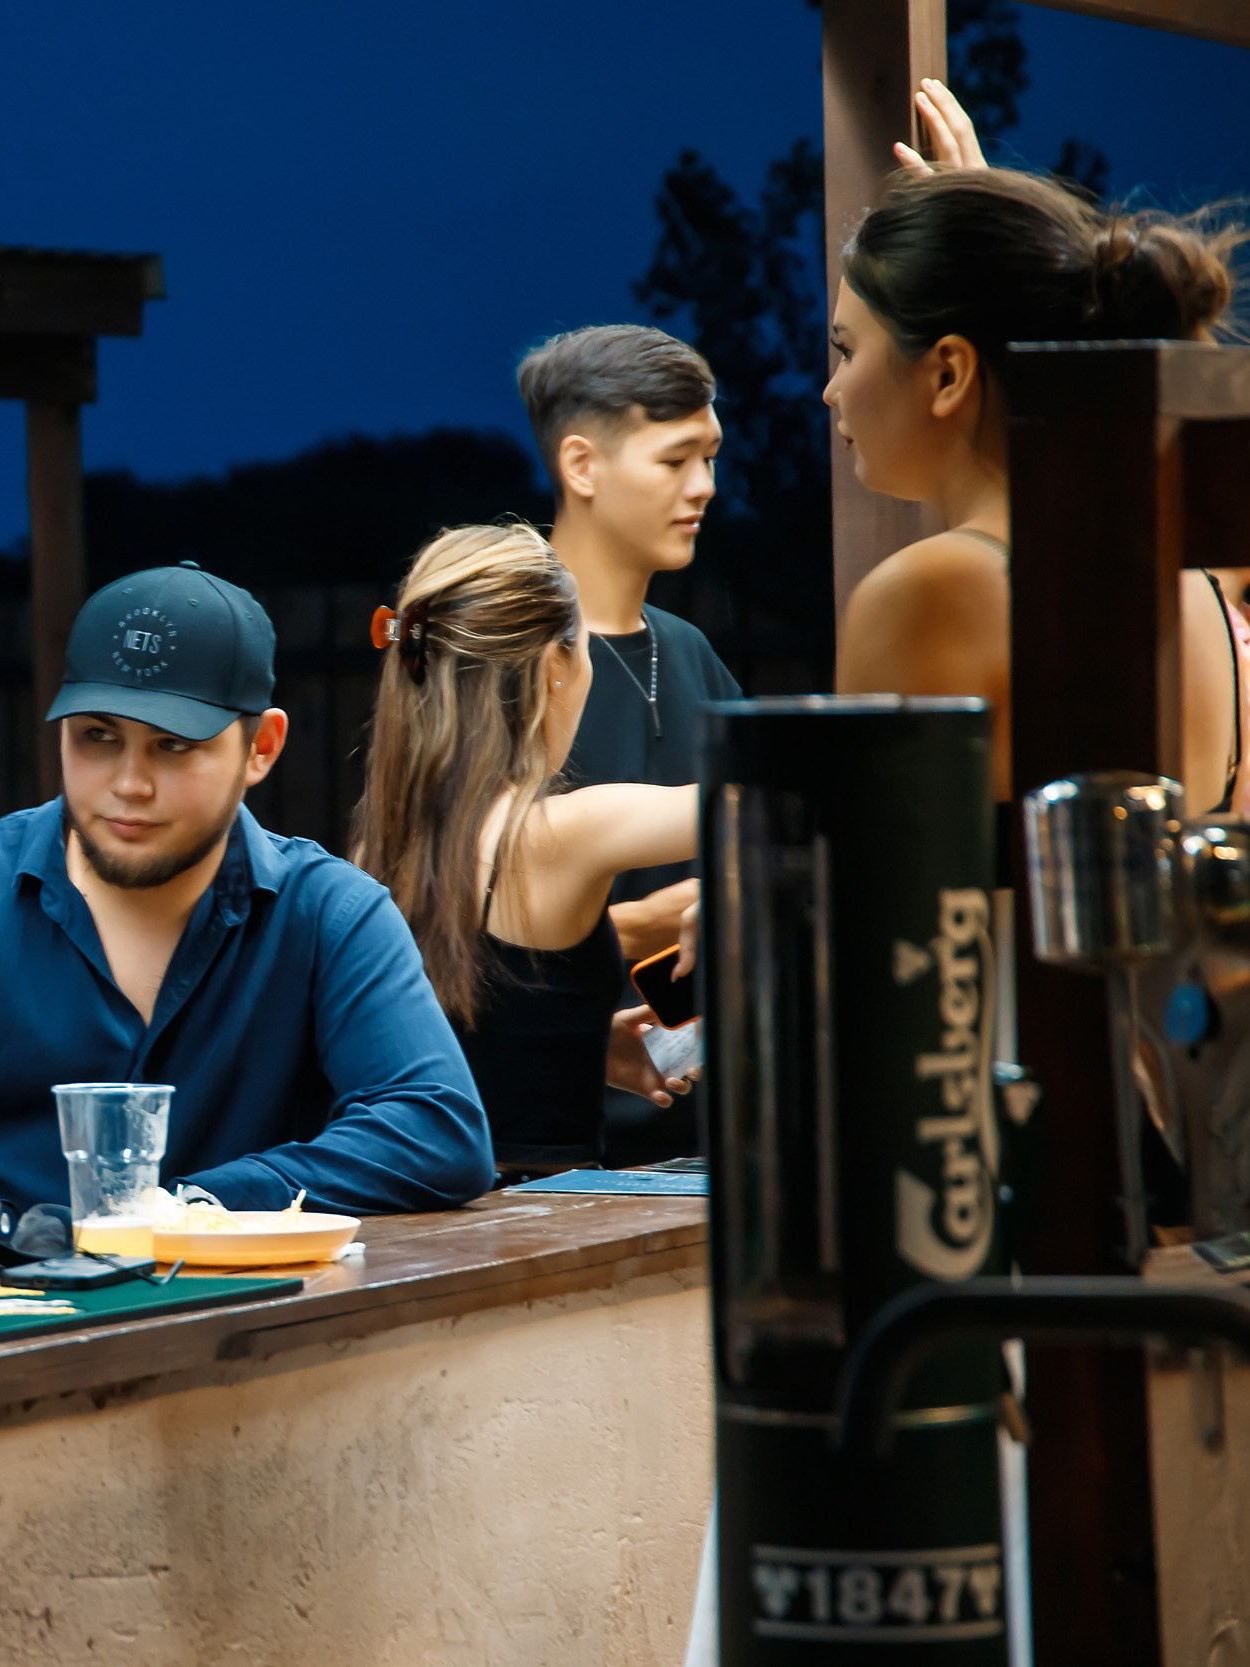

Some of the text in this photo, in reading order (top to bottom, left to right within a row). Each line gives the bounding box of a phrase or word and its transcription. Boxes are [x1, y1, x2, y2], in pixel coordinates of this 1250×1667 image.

[122, 629, 162, 654] NETS
[895, 888, 999, 1282] Carlsberg
[805, 1564, 969, 1625] 1847
